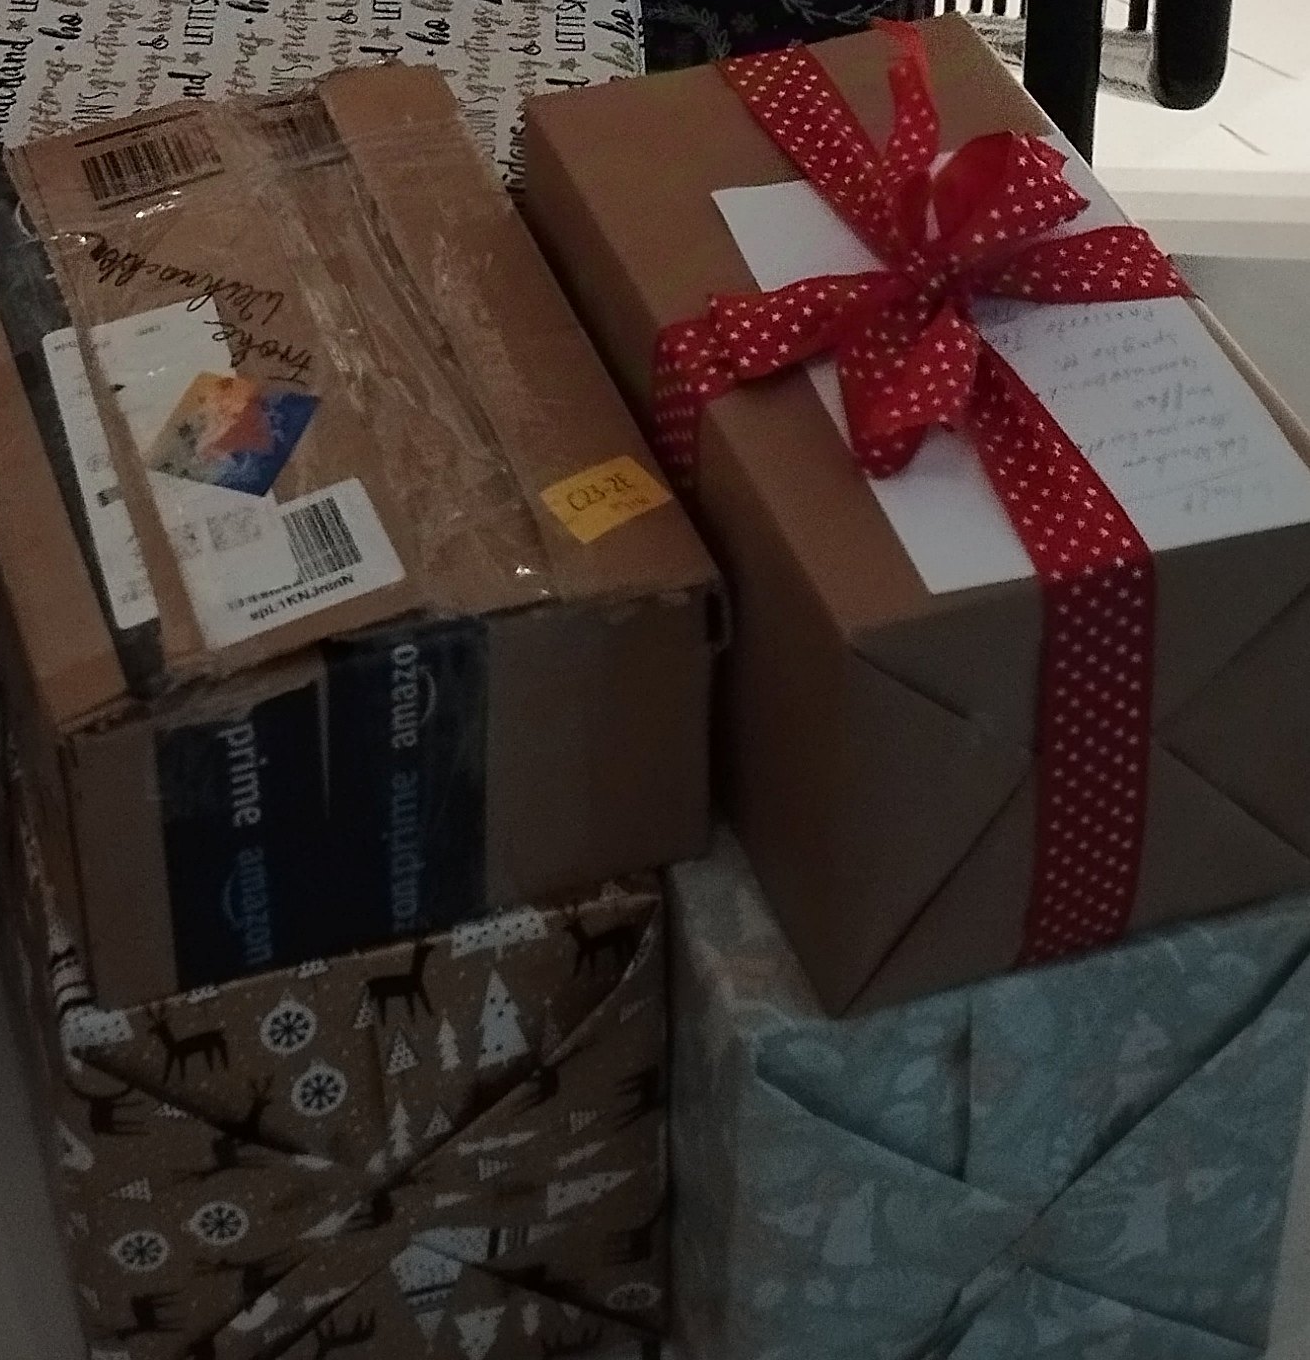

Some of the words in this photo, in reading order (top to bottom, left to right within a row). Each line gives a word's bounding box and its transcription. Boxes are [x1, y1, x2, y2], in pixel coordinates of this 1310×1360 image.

[38, 11, 83, 40] ho
[406, 18, 451, 45] ho
[218, 722, 270, 829] prime
[238, 844, 274, 967] amazon
